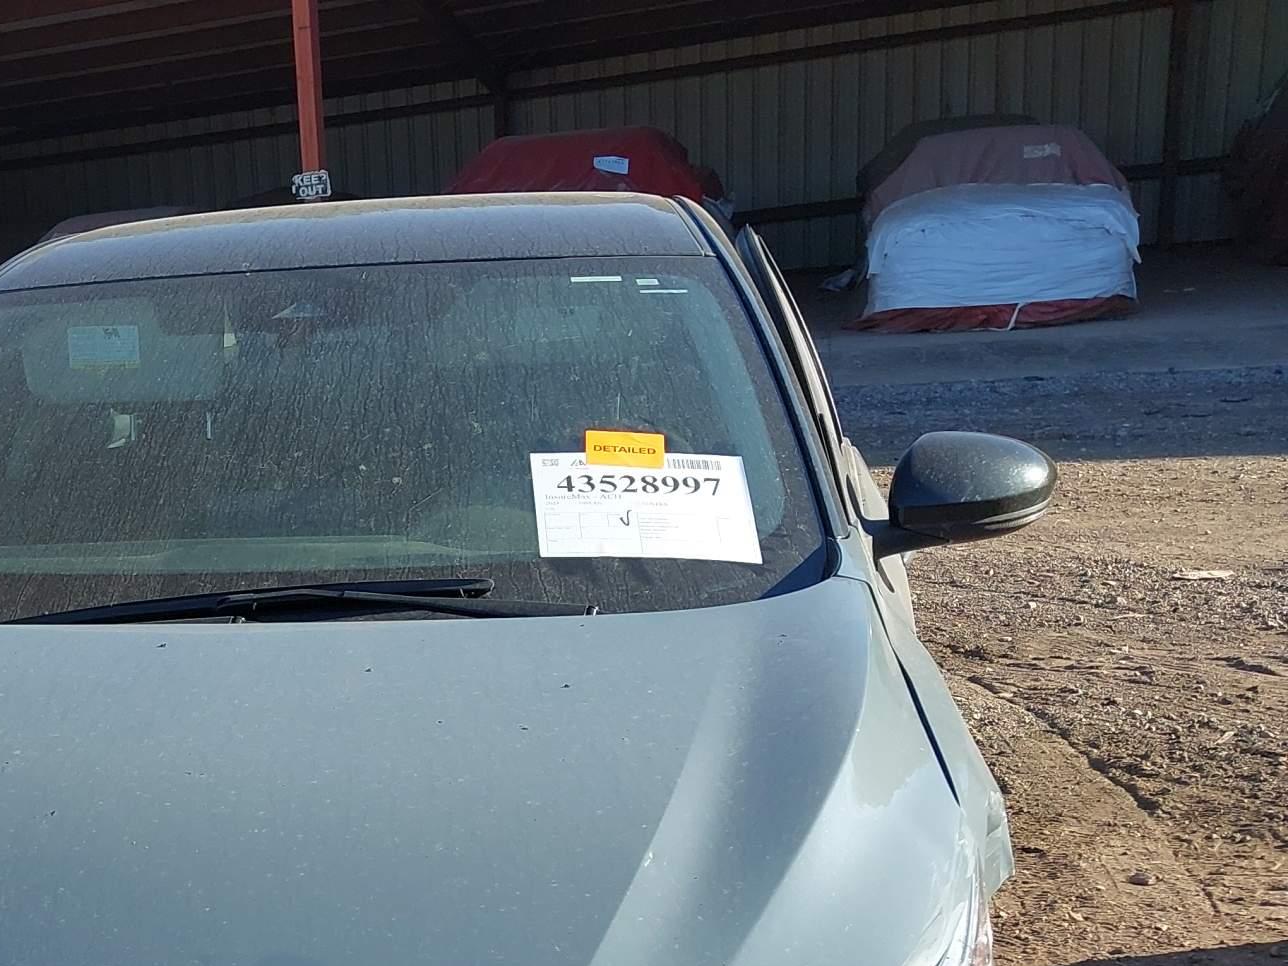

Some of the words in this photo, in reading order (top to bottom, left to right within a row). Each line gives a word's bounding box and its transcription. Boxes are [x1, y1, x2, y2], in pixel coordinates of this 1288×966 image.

[299, 185, 324, 197] OUT
[593, 444, 656, 455] DETAILED
[557, 474, 721, 496] 43528997
